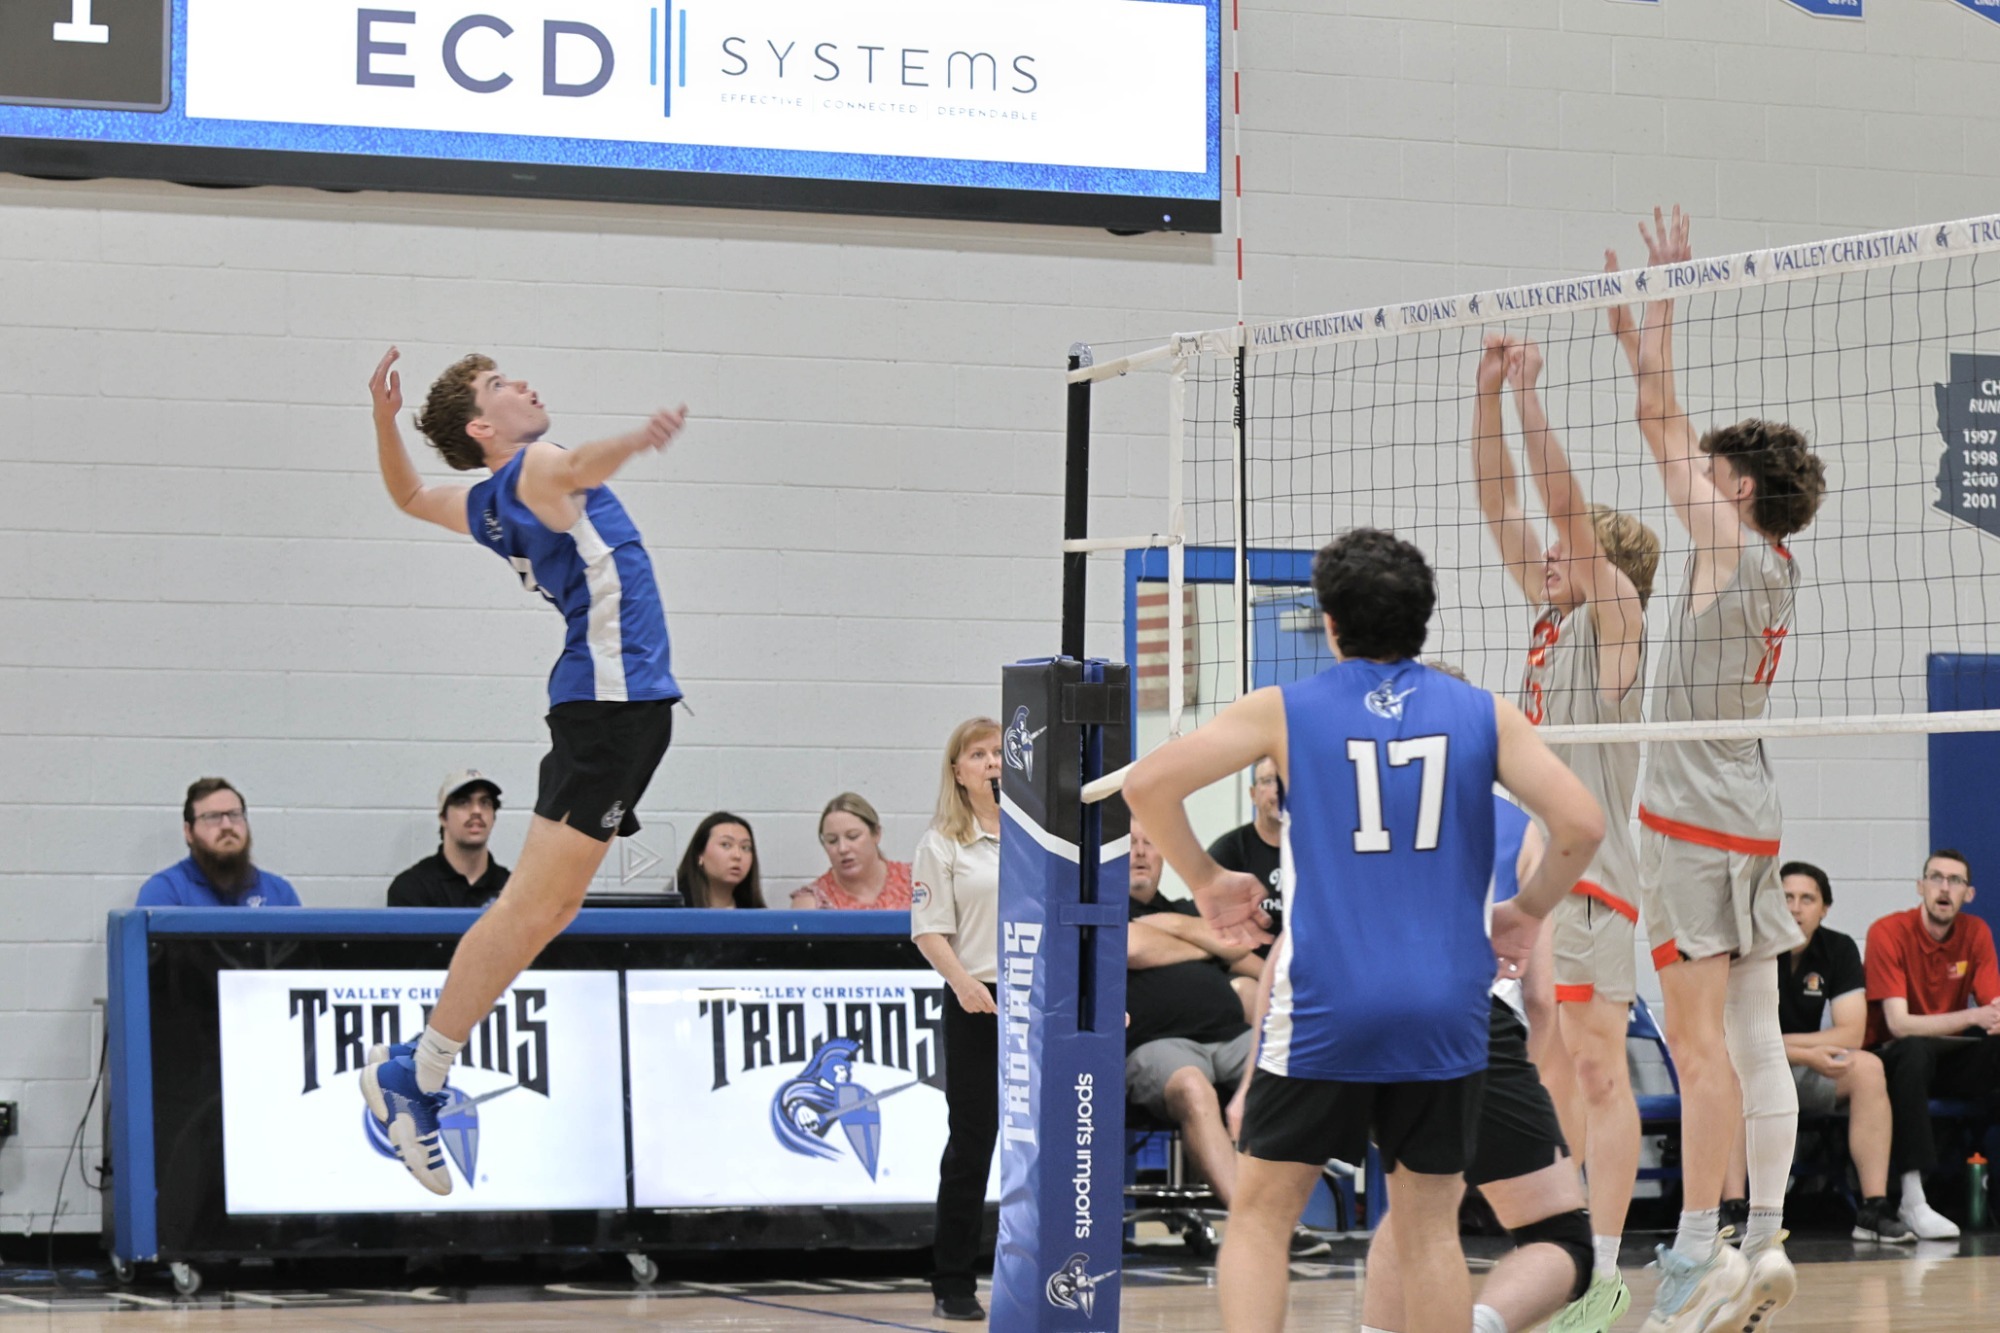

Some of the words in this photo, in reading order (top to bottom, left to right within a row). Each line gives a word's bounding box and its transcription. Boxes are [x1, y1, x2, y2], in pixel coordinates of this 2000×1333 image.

[356, 8, 615, 98] ECD
[721, 36, 1039, 94] SYSTEMS
[720, 92, 803, 107] EFFECTIVE
[823, 99, 918, 114] CONNECTED
[937, 106, 1038, 121] DEPENDABLE
[1253, 323, 1295, 346] VALLEY
[1295, 312, 1364, 340] CHRISTIAN
[1400, 299, 1457, 325] TROJANS
[1496, 288, 1543, 311] VALLEY
[1546, 276, 1622, 305] CHRISTIAN
[1664, 260, 1731, 289] TROJANS
[1773, 244, 1828, 271] VALLEY
[1831, 231, 1919, 263] CHRISTIAN
[1962, 429, 1998, 445] 1997
[1962, 450, 1999, 466] 1998
[1961, 471, 1999, 487] 2000
[1961, 493, 1998, 509] 2001
[1345, 733, 1449, 853] 17
[333, 987, 402, 1000] VALLEY
[812, 986, 906, 999] CHRISTIAN
[1003, 921, 1043, 1151] TROJANS
[1074, 1072, 1095, 1146] sports
[1072, 1149, 1093, 1239] imports
